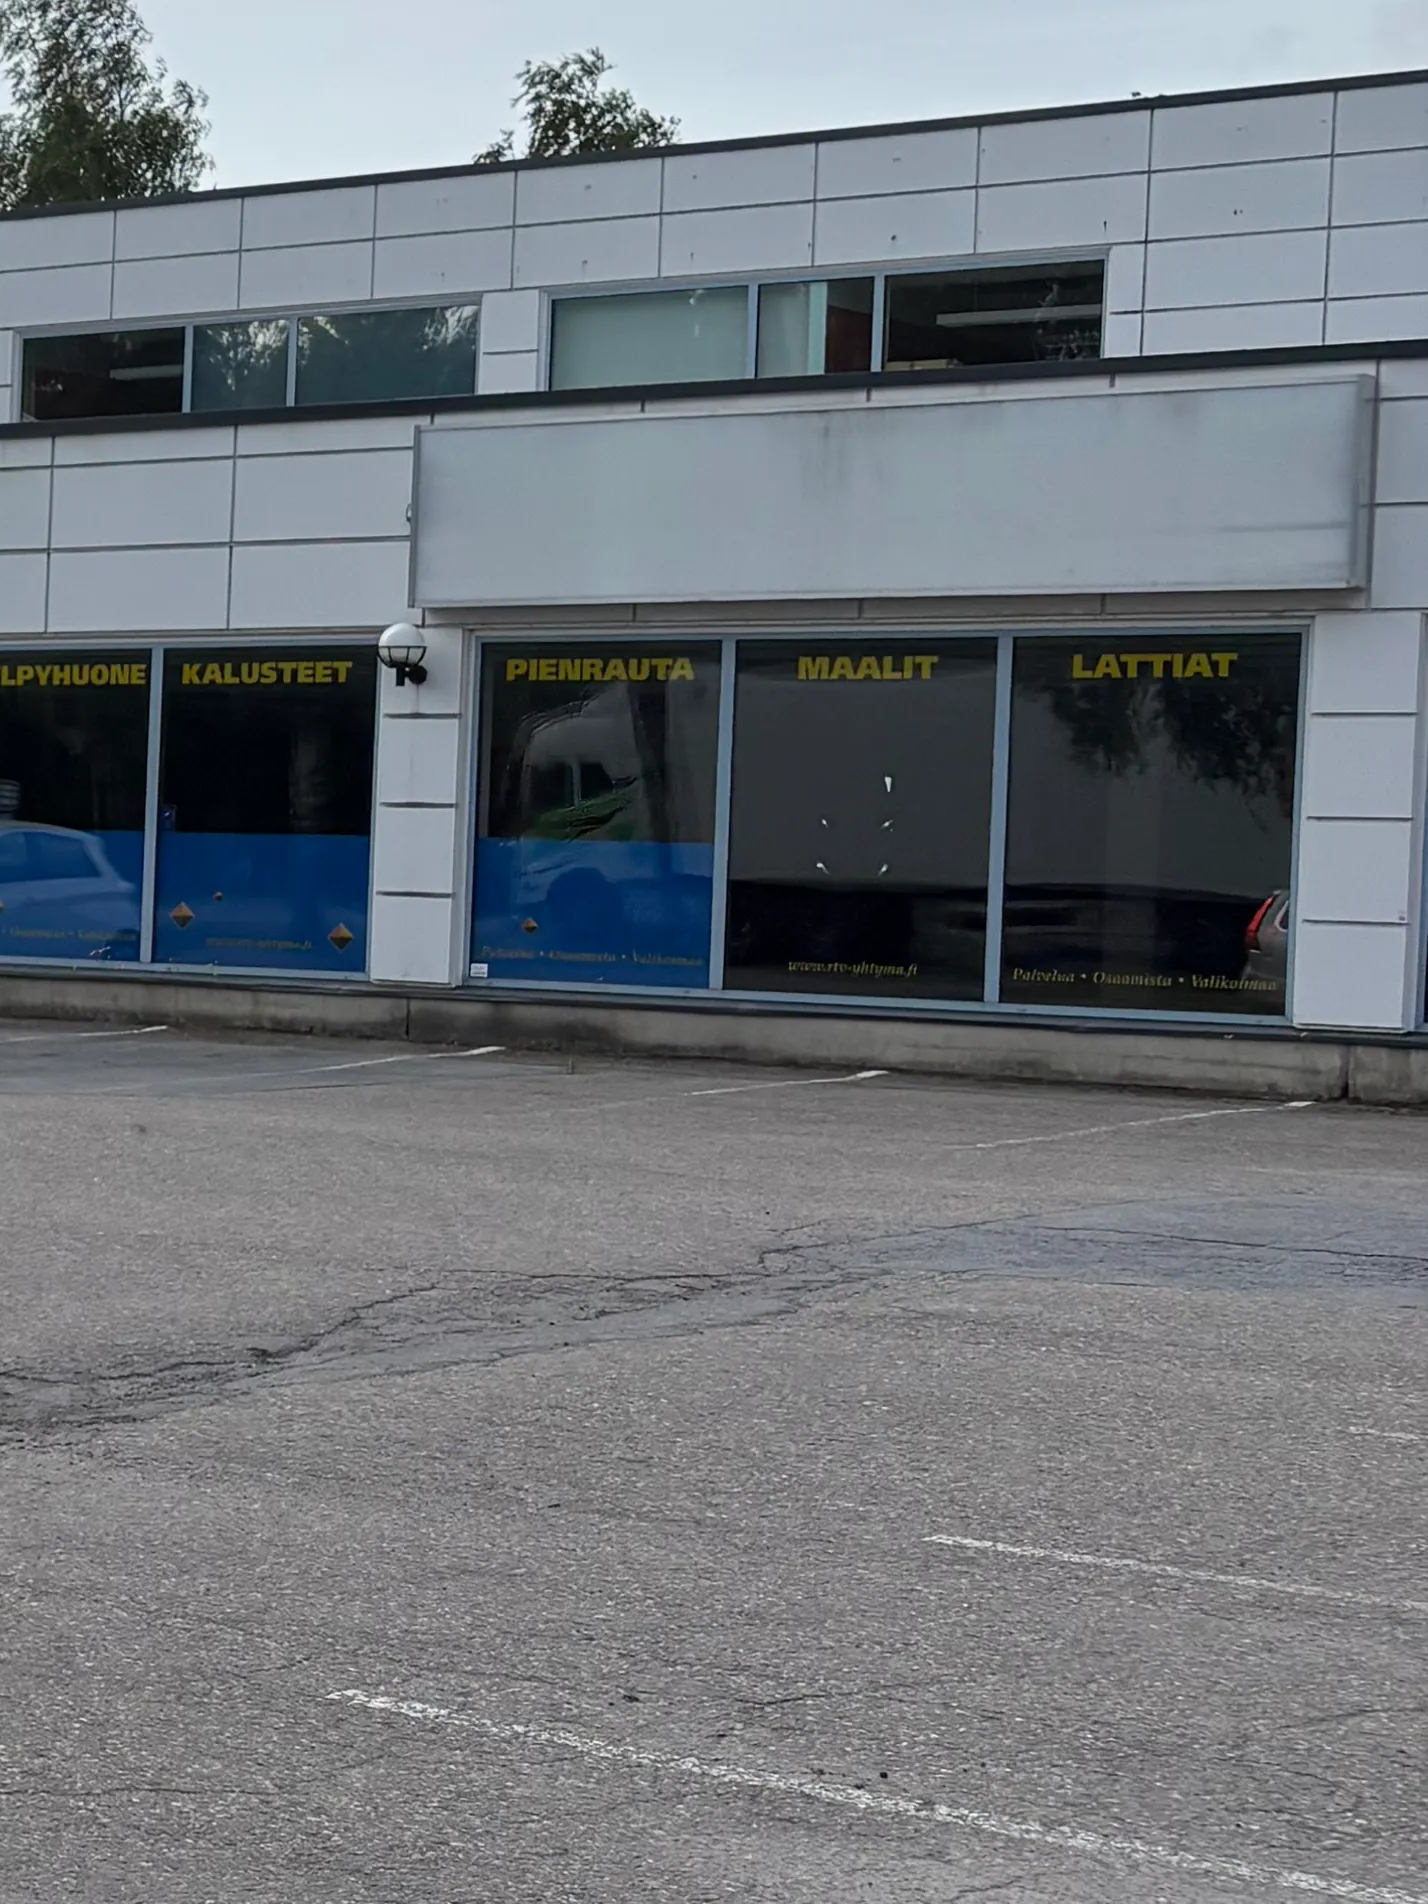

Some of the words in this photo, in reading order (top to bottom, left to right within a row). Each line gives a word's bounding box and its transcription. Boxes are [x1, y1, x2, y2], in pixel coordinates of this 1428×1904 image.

[181, 660, 353, 685] KALUSTEET
[505, 657, 695, 681] PIENRAUTA
[796, 655, 939, 680] MAALIT
[1071, 652, 1238, 679] LATTIAT
[1011, 967, 1076, 983] Palvelua
[1092, 971, 1173, 987] Osaamista
[1191, 974, 1277, 991] Valikoimaa
